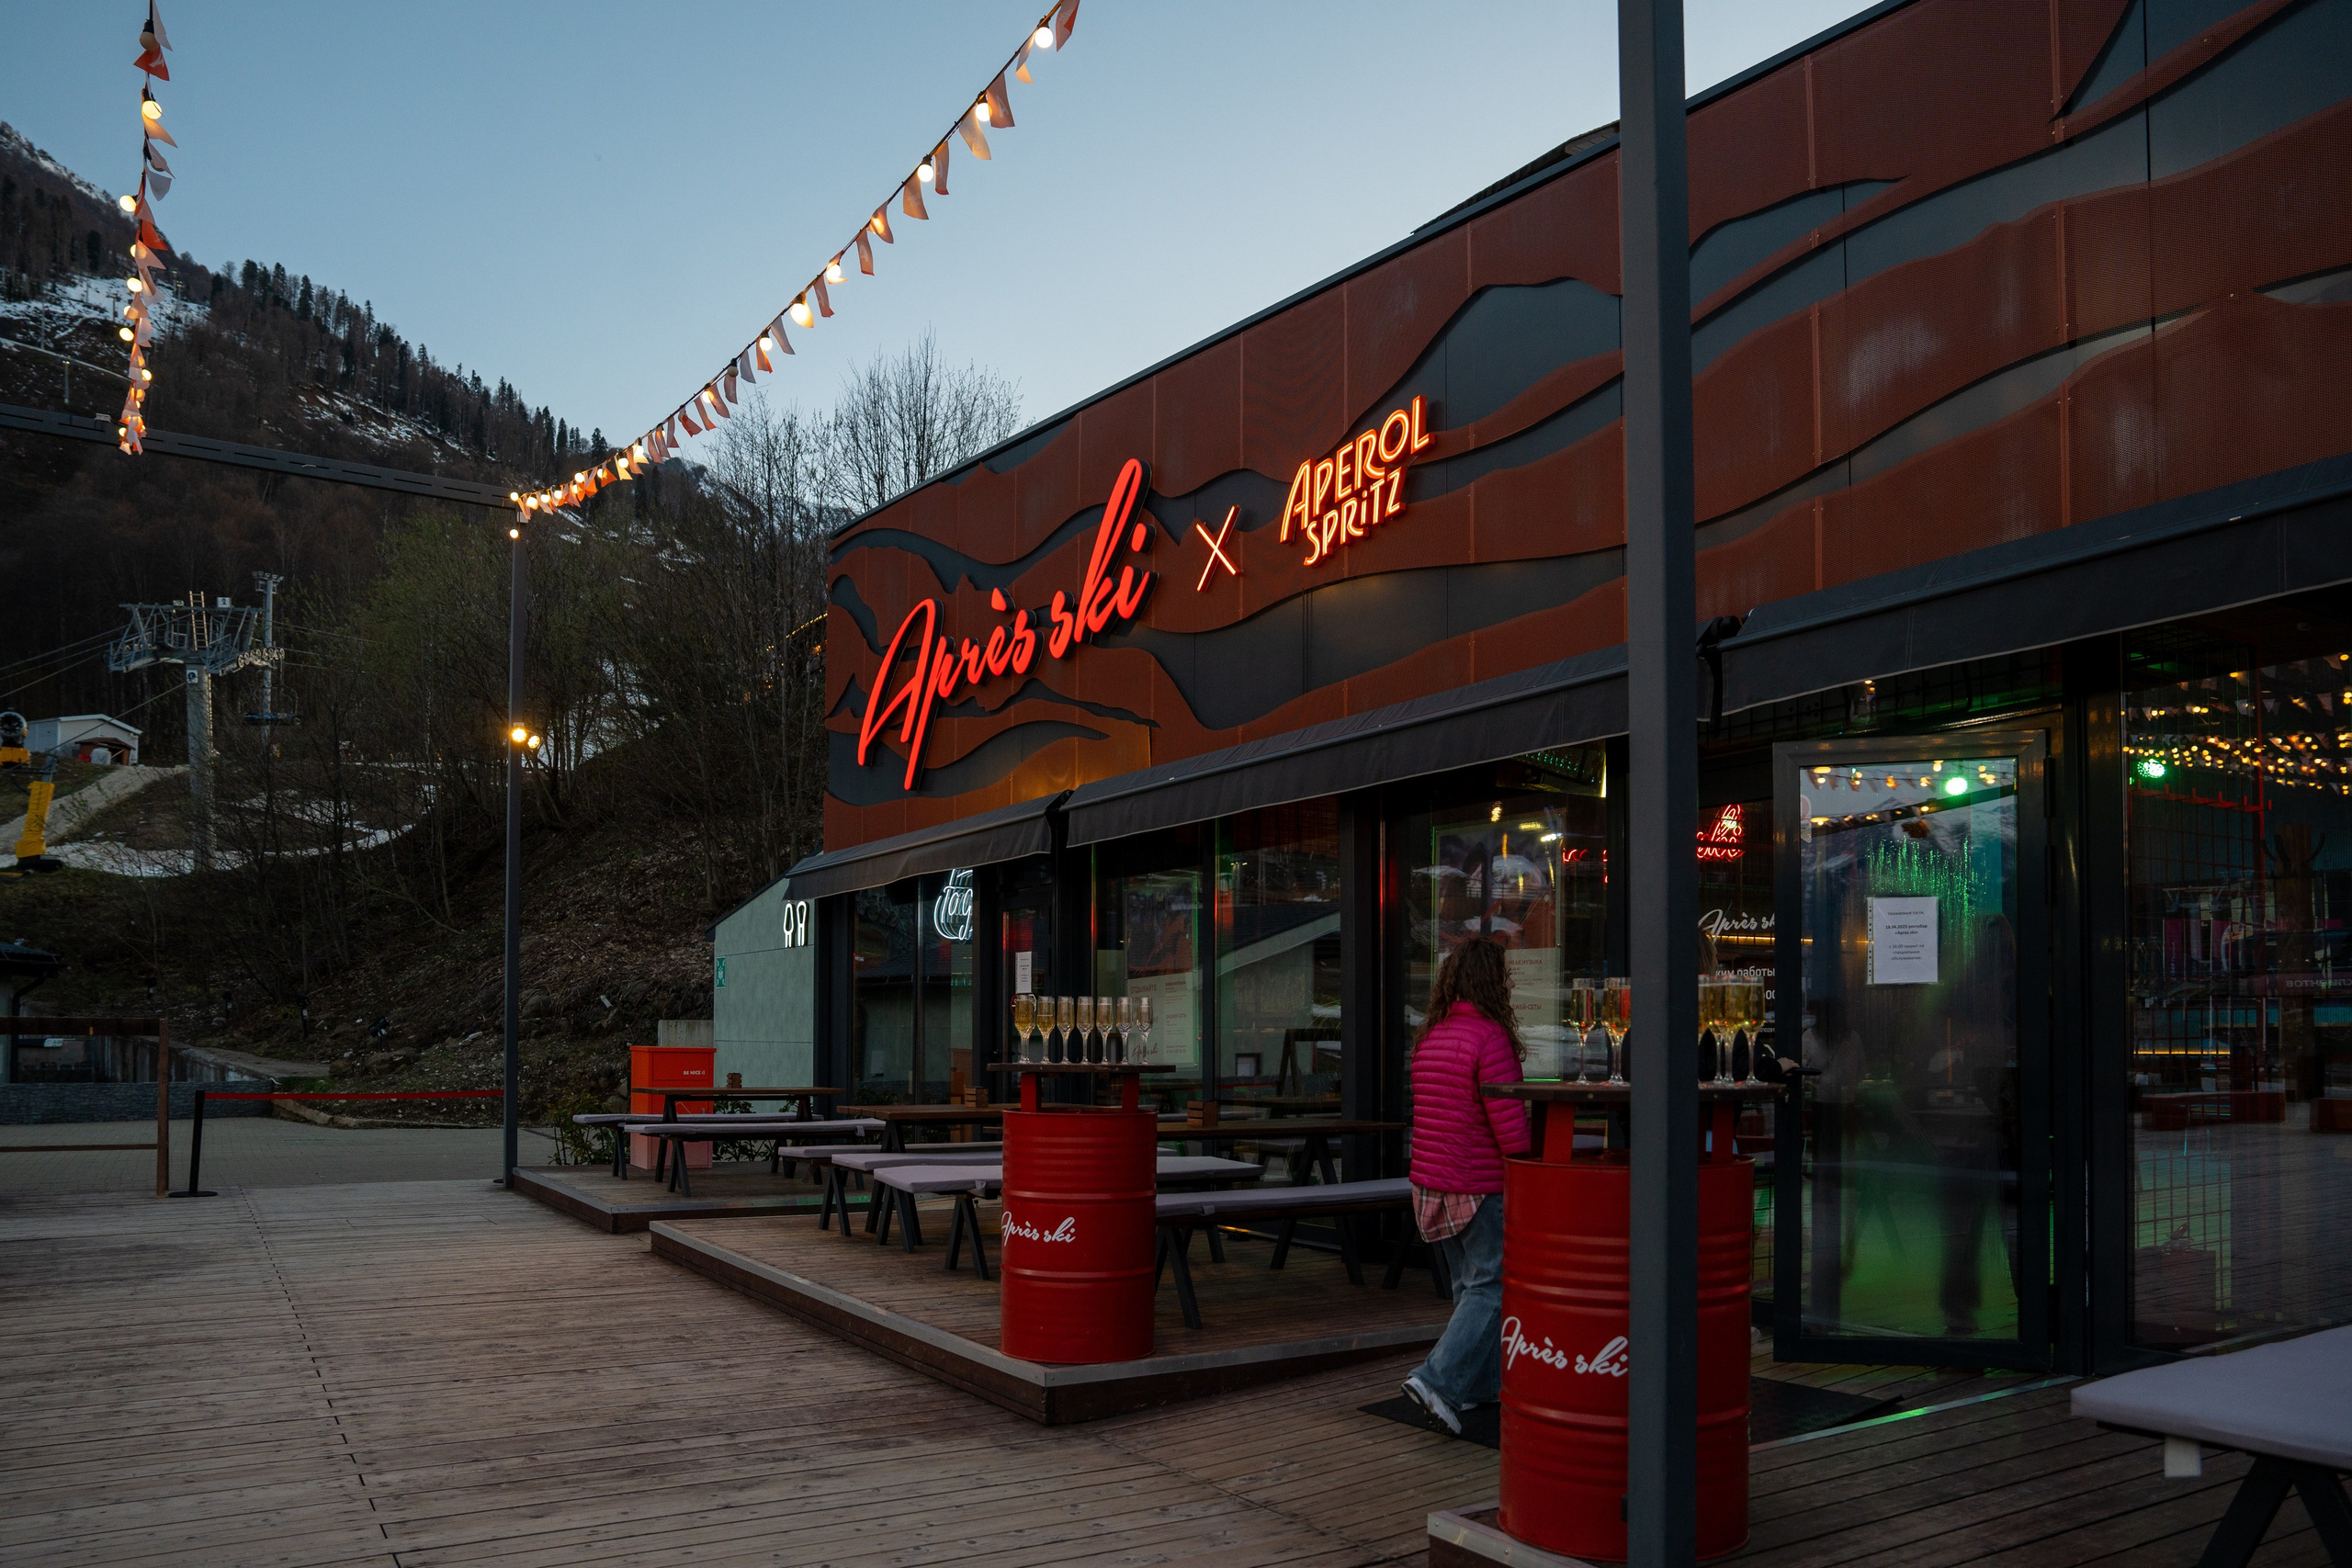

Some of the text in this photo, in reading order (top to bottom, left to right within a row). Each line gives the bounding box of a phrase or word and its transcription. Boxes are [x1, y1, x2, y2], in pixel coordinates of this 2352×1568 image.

[1280, 395, 1435, 544] APEROL
[858, 458, 1159, 790] Après ski
[1697, 908, 1758, 943] Après
[1001, 1211, 1076, 1247] Après ski
[1500, 1315, 1629, 1378] Après ski
